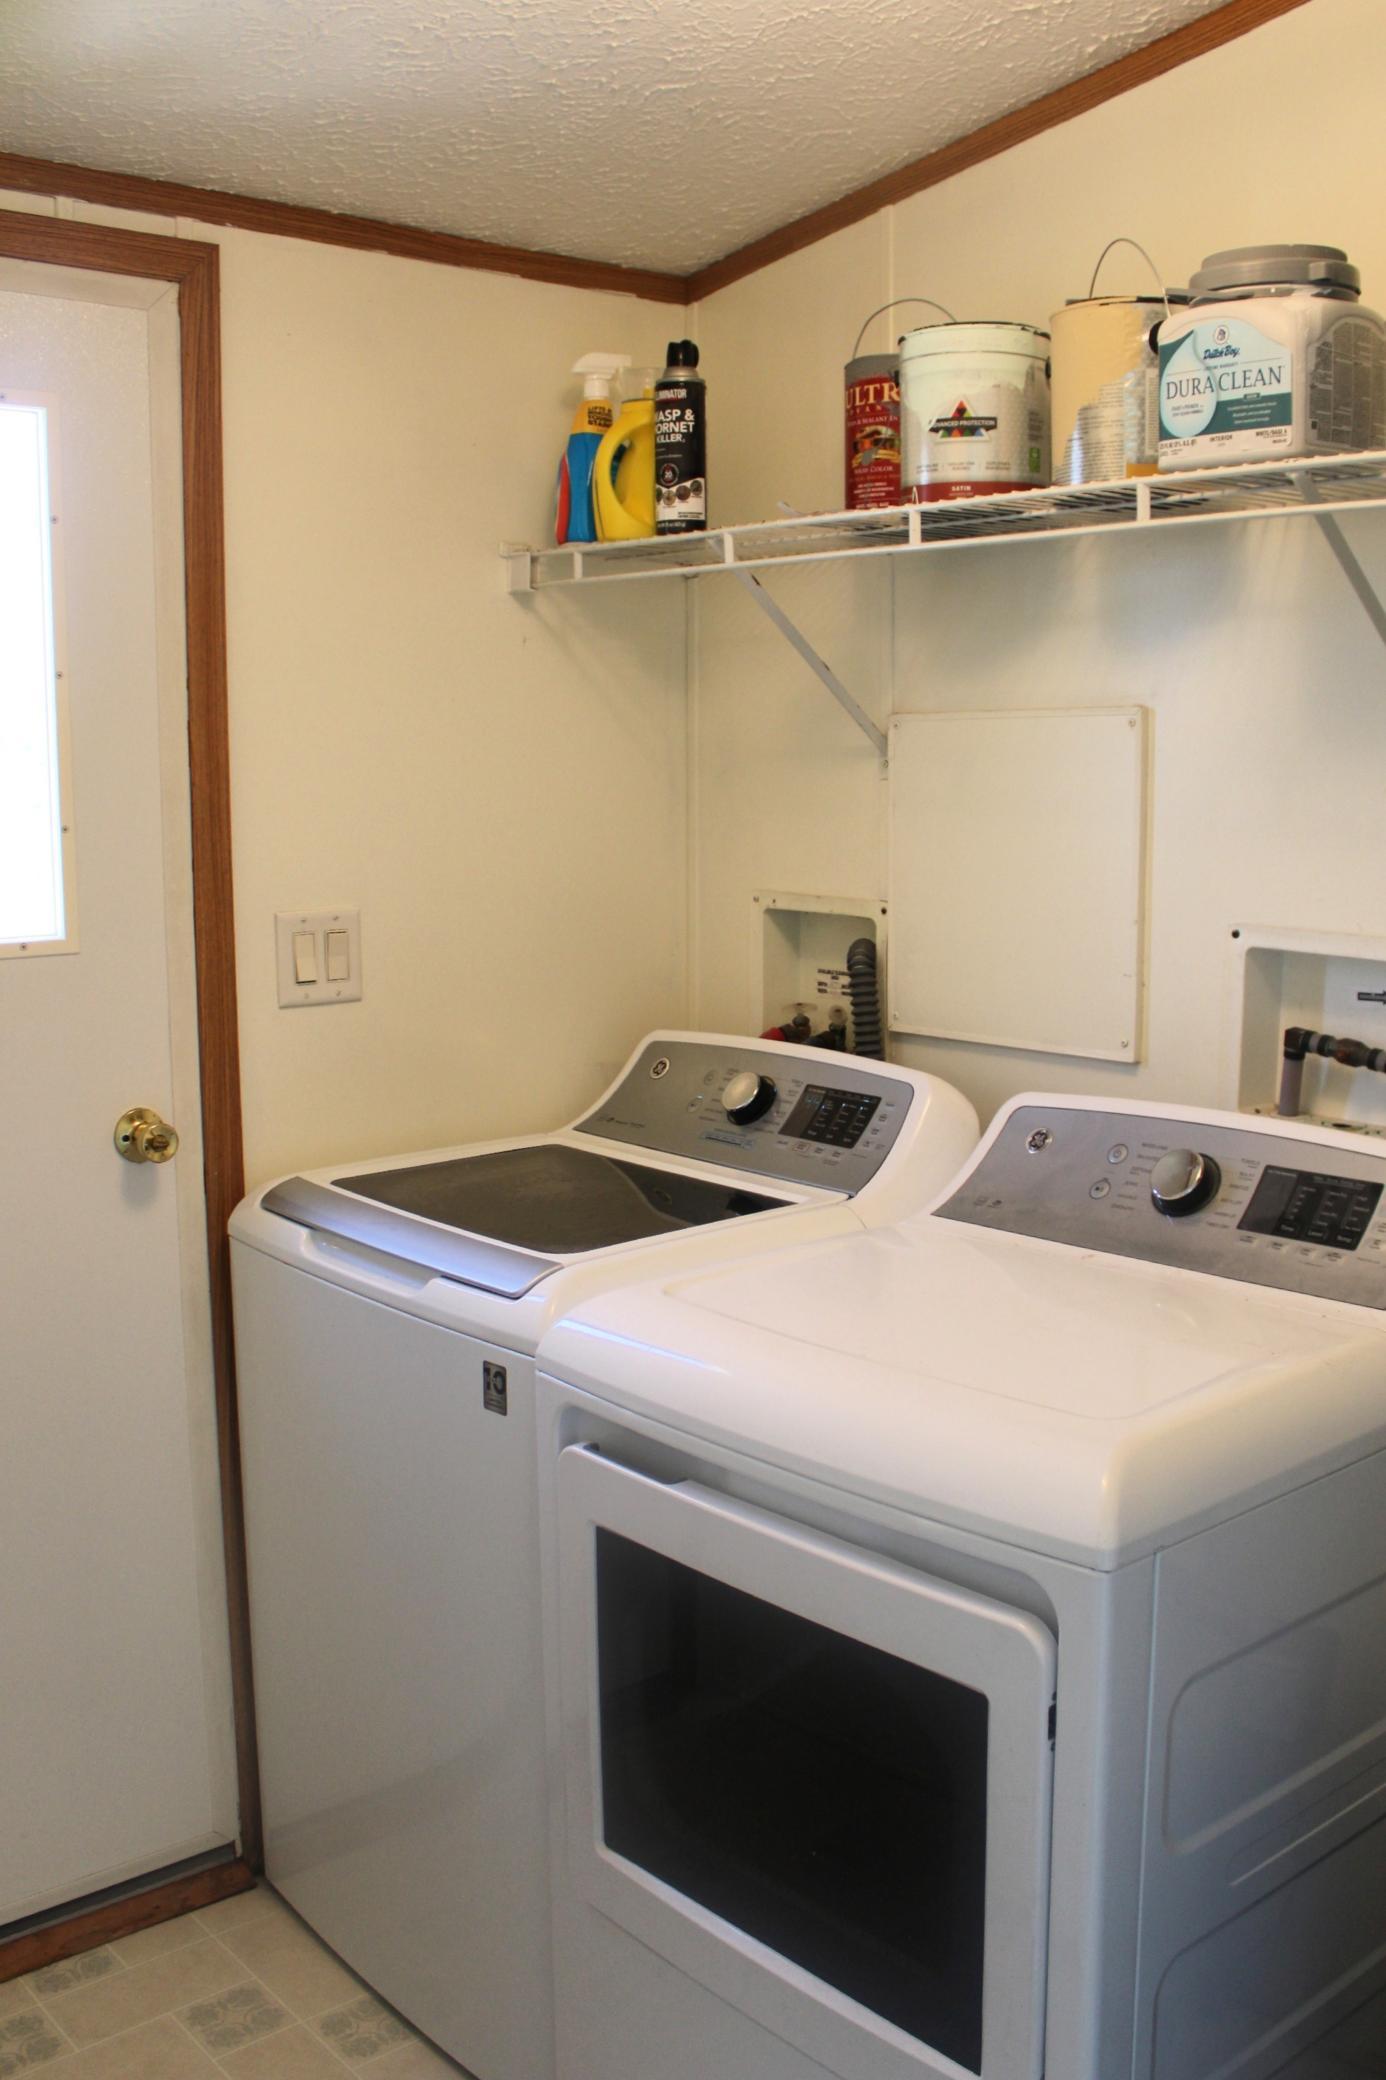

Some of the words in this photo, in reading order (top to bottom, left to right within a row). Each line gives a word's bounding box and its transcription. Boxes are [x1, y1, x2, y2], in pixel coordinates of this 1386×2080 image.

[1203, 348, 1223, 360] Dutch
[1224, 344, 1240, 358] Boy
[1166, 376, 1215, 400] DURA
[1218, 366, 1282, 391] CLEAN
[656, 388, 687, 401] LIMINATOR
[846, 382, 900, 409] ULTR
[684, 408, 695, 421] &
[656, 421, 695, 434] ORNET
